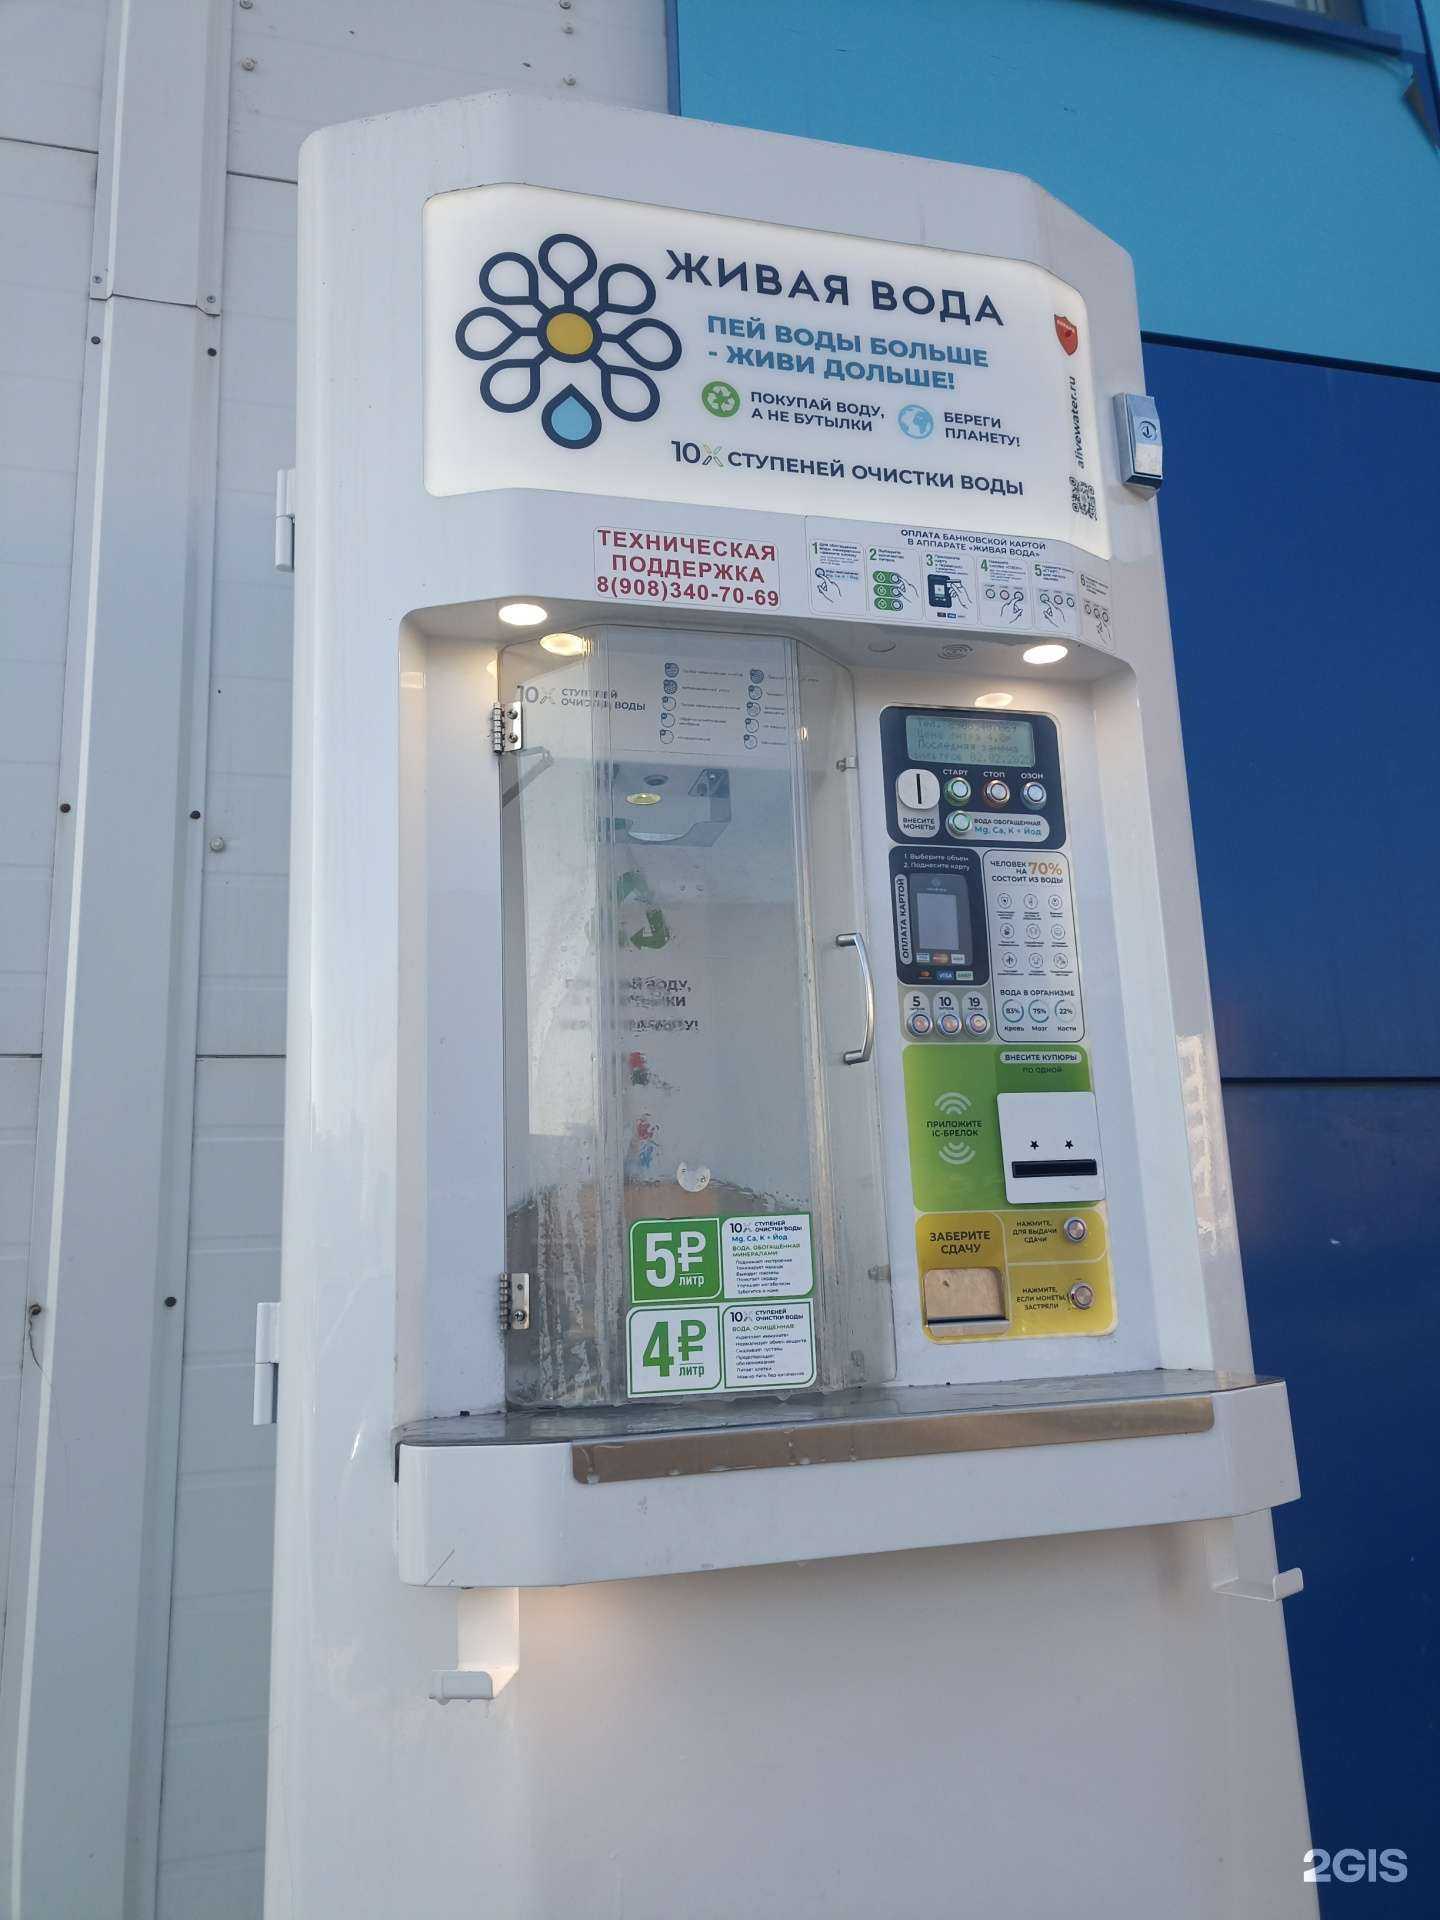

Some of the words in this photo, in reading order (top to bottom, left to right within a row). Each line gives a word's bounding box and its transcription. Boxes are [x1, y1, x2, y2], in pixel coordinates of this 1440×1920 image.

[665, 249, 849, 306] ЖИВАЯ
[871, 280, 1004, 326] ВОДА
[708, 315, 766, 341] ПЕЙ
[775, 325, 861, 354] ВОДЫ
[870, 337, 989, 368] БОЛЬШЕ
[726, 345, 815, 374] ЖИВИ
[823, 359, 955, 390] ДОЛЬШЕ!
[750, 391, 832, 411] ПОКУПАЙ
[836, 402, 885, 419] ВОДУ,
[751, 408, 763, 420] А
[768, 410, 790, 422] НЕ
[794, 413, 873, 432] БУТЫЛКИ
[944, 412, 1002, 429] БЕРЕГИ
[1069, 376, 1085, 470] alivewater.ru
[945, 427, 1021, 448] ПЛАНЕТУ!
[727, 451, 845, 478] СТУПЕНЕЙ
[851, 464, 954, 489] ОЧИСТКИ
[960, 475, 1024, 496] ВОДЫ
[597, 529, 776, 562] ТЕХНИЧЕСКАЯ
[900, 529, 940, 539] ОПЛАТА
[942, 533, 1008, 546] БАНКОВСКОЙ
[1009, 540, 1046, 550] КАРТОЙ
[812, 542, 818, 554] 1
[869, 548, 877, 560] 2
[907, 538, 914, 546] В
[916, 539, 967, 551] АППАРАТЕ
[968, 544, 1007, 554] «ЖИВАЯ
[1009, 548, 1041, 558] ВОДА»
[926, 554, 934, 566] 3
[980, 559, 988, 572] 4
[611, 554, 765, 583] ПОДДЕРЖКА
[1034, 564, 1042, 577] 5
[1080, 574, 1086, 586] 6
[597, 576, 779, 607] 8(908)340-70-69
[614, 701, 646, 711] ВОДЫ
[1020, 772, 1044, 780] ОЗОН
[902, 817, 935, 825] ВНЕСИТЕ
[1028, 862, 1063, 876] 70%
[897, 879, 908, 917] КАРТОЙ
[900, 920, 910, 959] ОПЛАТА
[1000, 989, 1022, 997] ВОДА
[1029, 989, 1075, 997] ОРГАНИЗМЕ
[912, 996, 921, 1007] 5
[940, 996, 952, 1007] 10
[969, 997, 981, 1008] 19
[926, 1120, 983, 1128] ПРИЛОЖИТЕ
[930, 1231, 991, 1242] ЗАБЕРИТЕ
[1012, 1228, 1027, 1236] ДЛЯ
[941, 1244, 981, 1255] СДАЧУ
[679, 1275, 705, 1288] литр
[679, 1365, 705, 1378] литр
